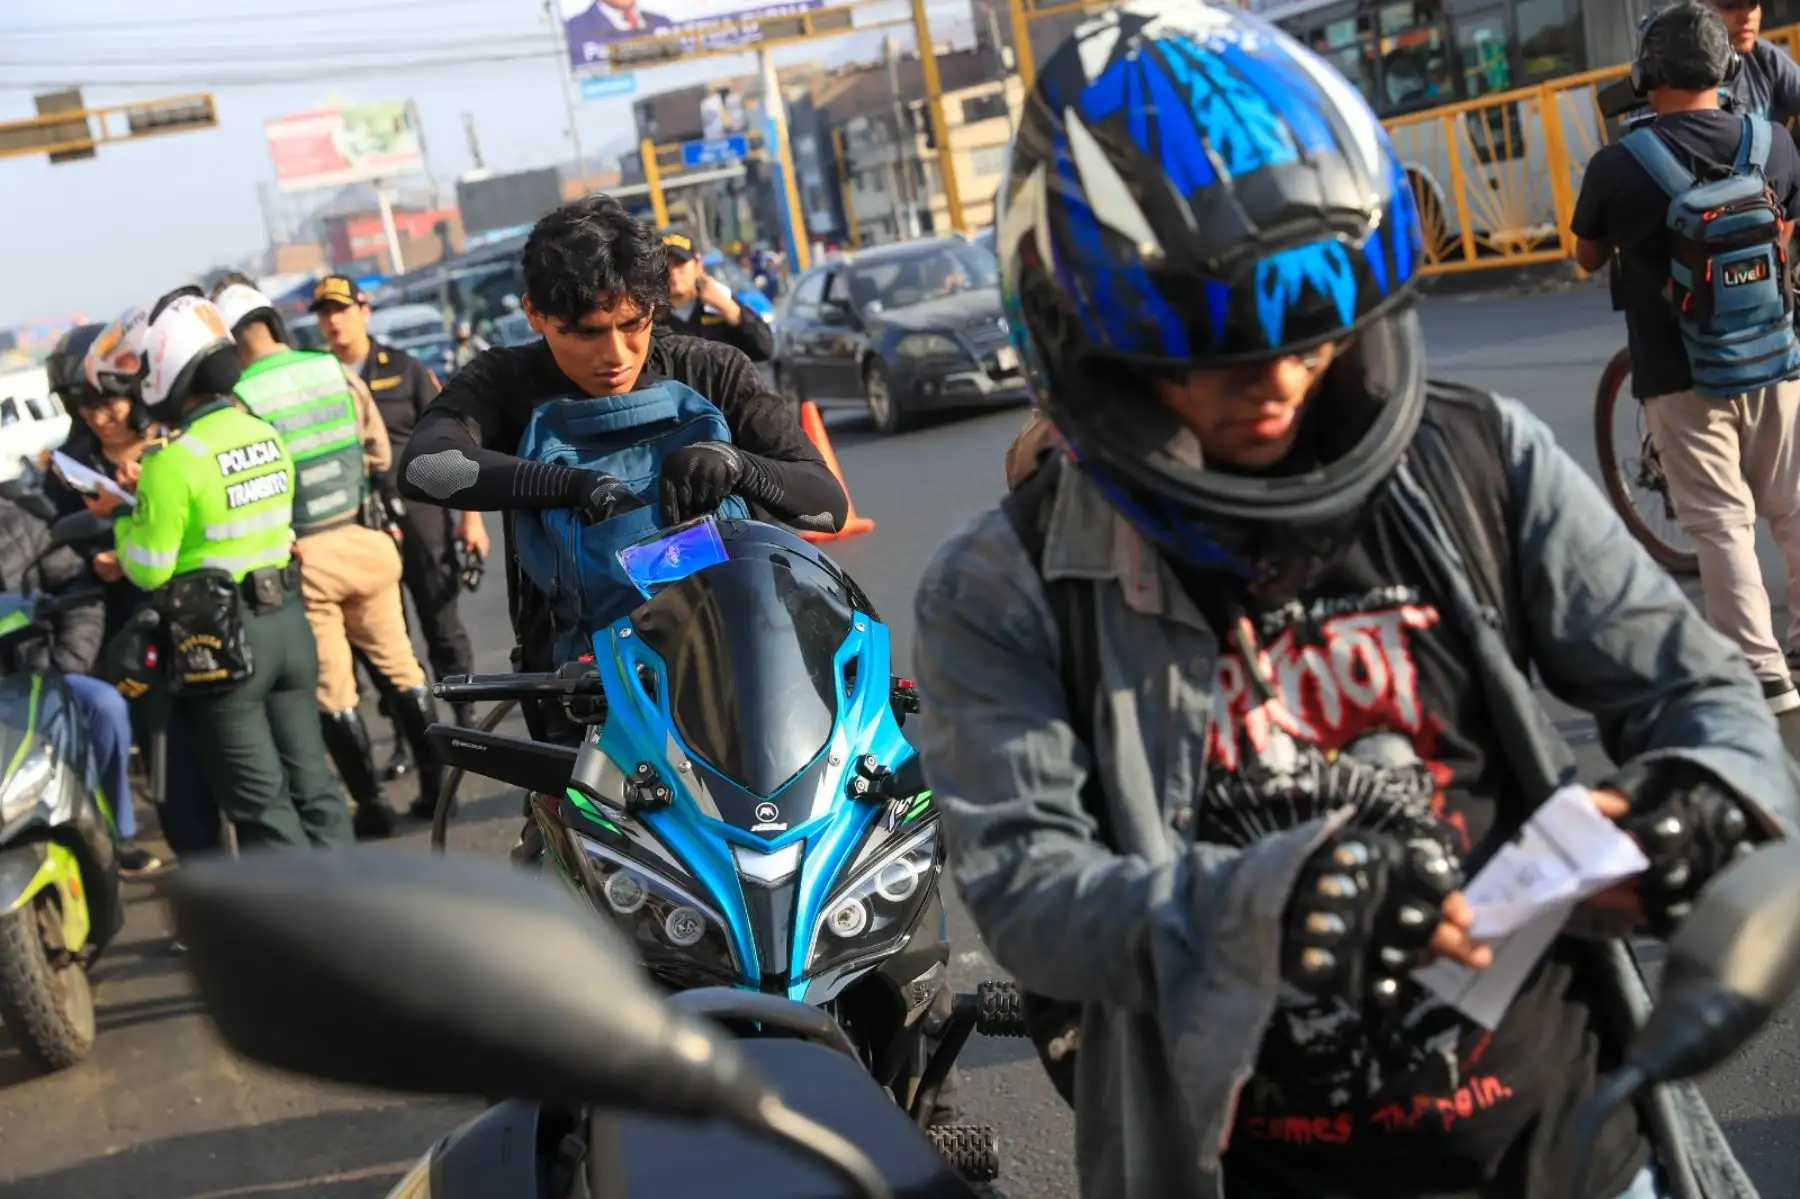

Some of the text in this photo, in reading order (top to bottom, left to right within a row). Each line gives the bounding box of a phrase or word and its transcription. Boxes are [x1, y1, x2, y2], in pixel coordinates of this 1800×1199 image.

[1724, 262, 1768, 286] LiveU
[216, 438, 281, 477] POLICIA
[225, 470, 289, 509] TRANSITO
